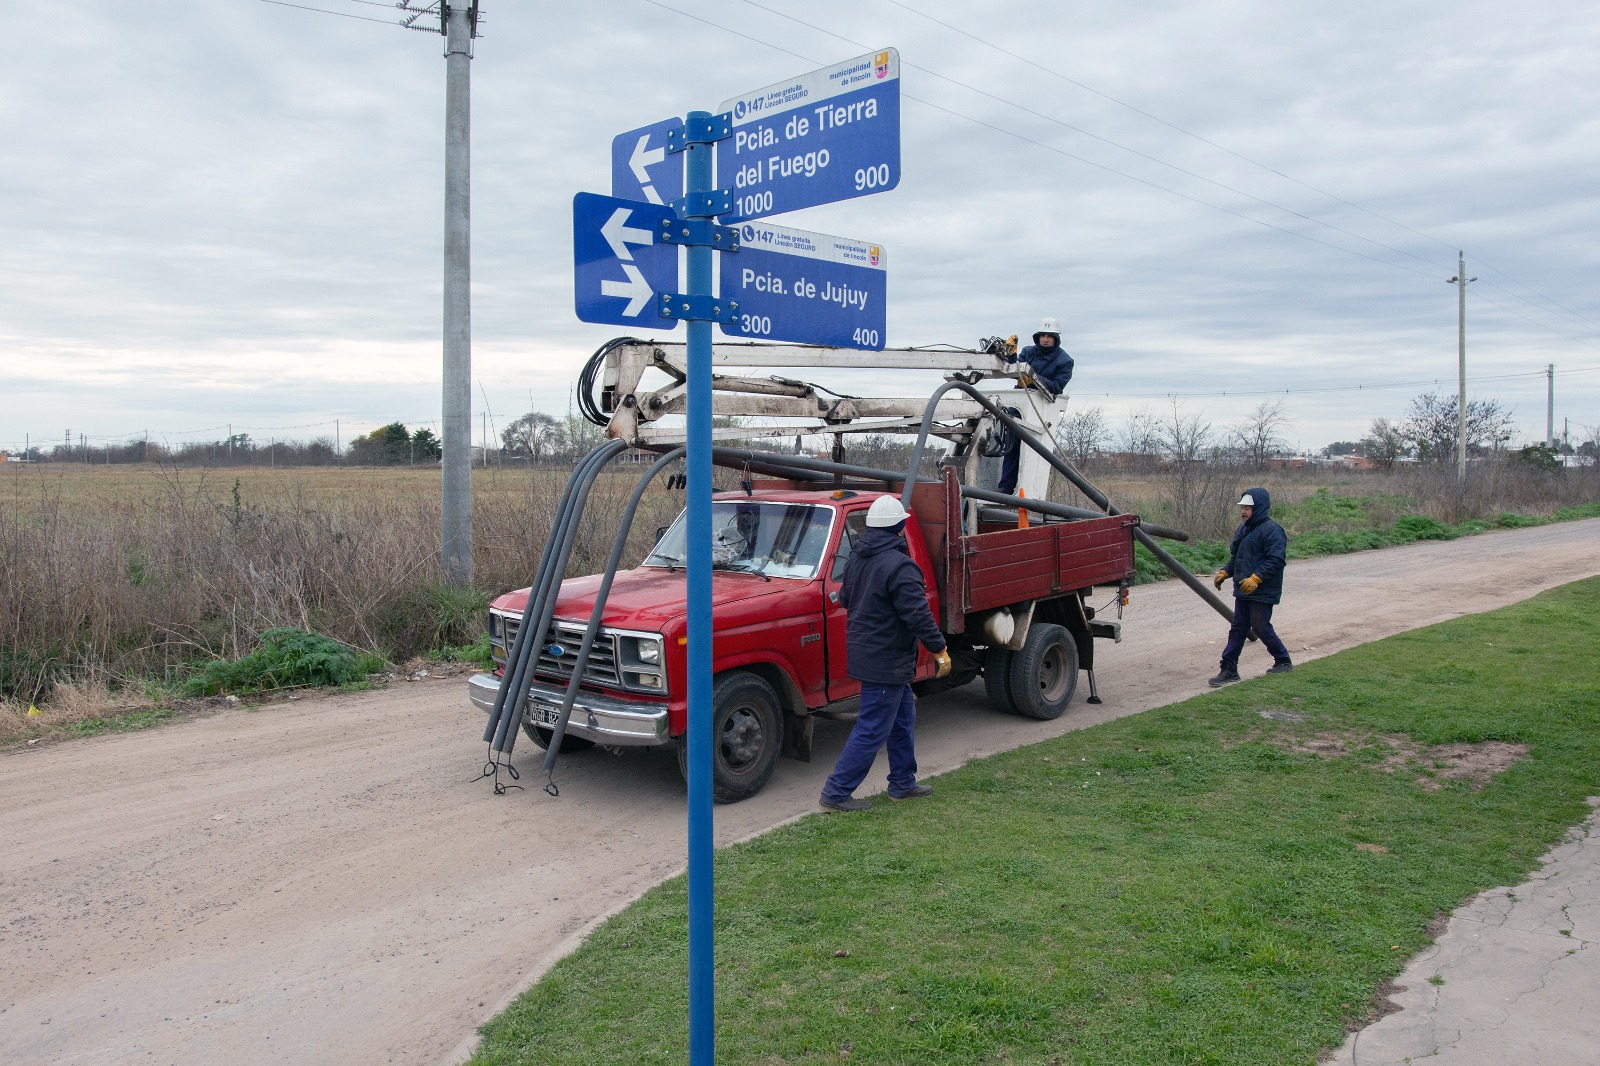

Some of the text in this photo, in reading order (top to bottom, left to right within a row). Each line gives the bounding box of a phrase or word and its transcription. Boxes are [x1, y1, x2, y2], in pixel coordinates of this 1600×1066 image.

[829, 61, 871, 80] municipalidad
[841, 72, 871, 86] de lincoln
[747, 96, 765, 114] 147
[764, 89, 809, 109] Lincoln SEGURO
[735, 97, 878, 155] Pcia. de Tierra
[735, 148, 830, 189] del Fuego
[854, 163, 890, 191] 900
[736, 190, 773, 217] 1000
[756, 230, 774, 243] 147
[793, 242, 816, 252] SEGURO
[742, 268, 868, 311] Pcia. de Jujuy
[741, 314, 771, 335] 300
[852, 327, 878, 347] 400
